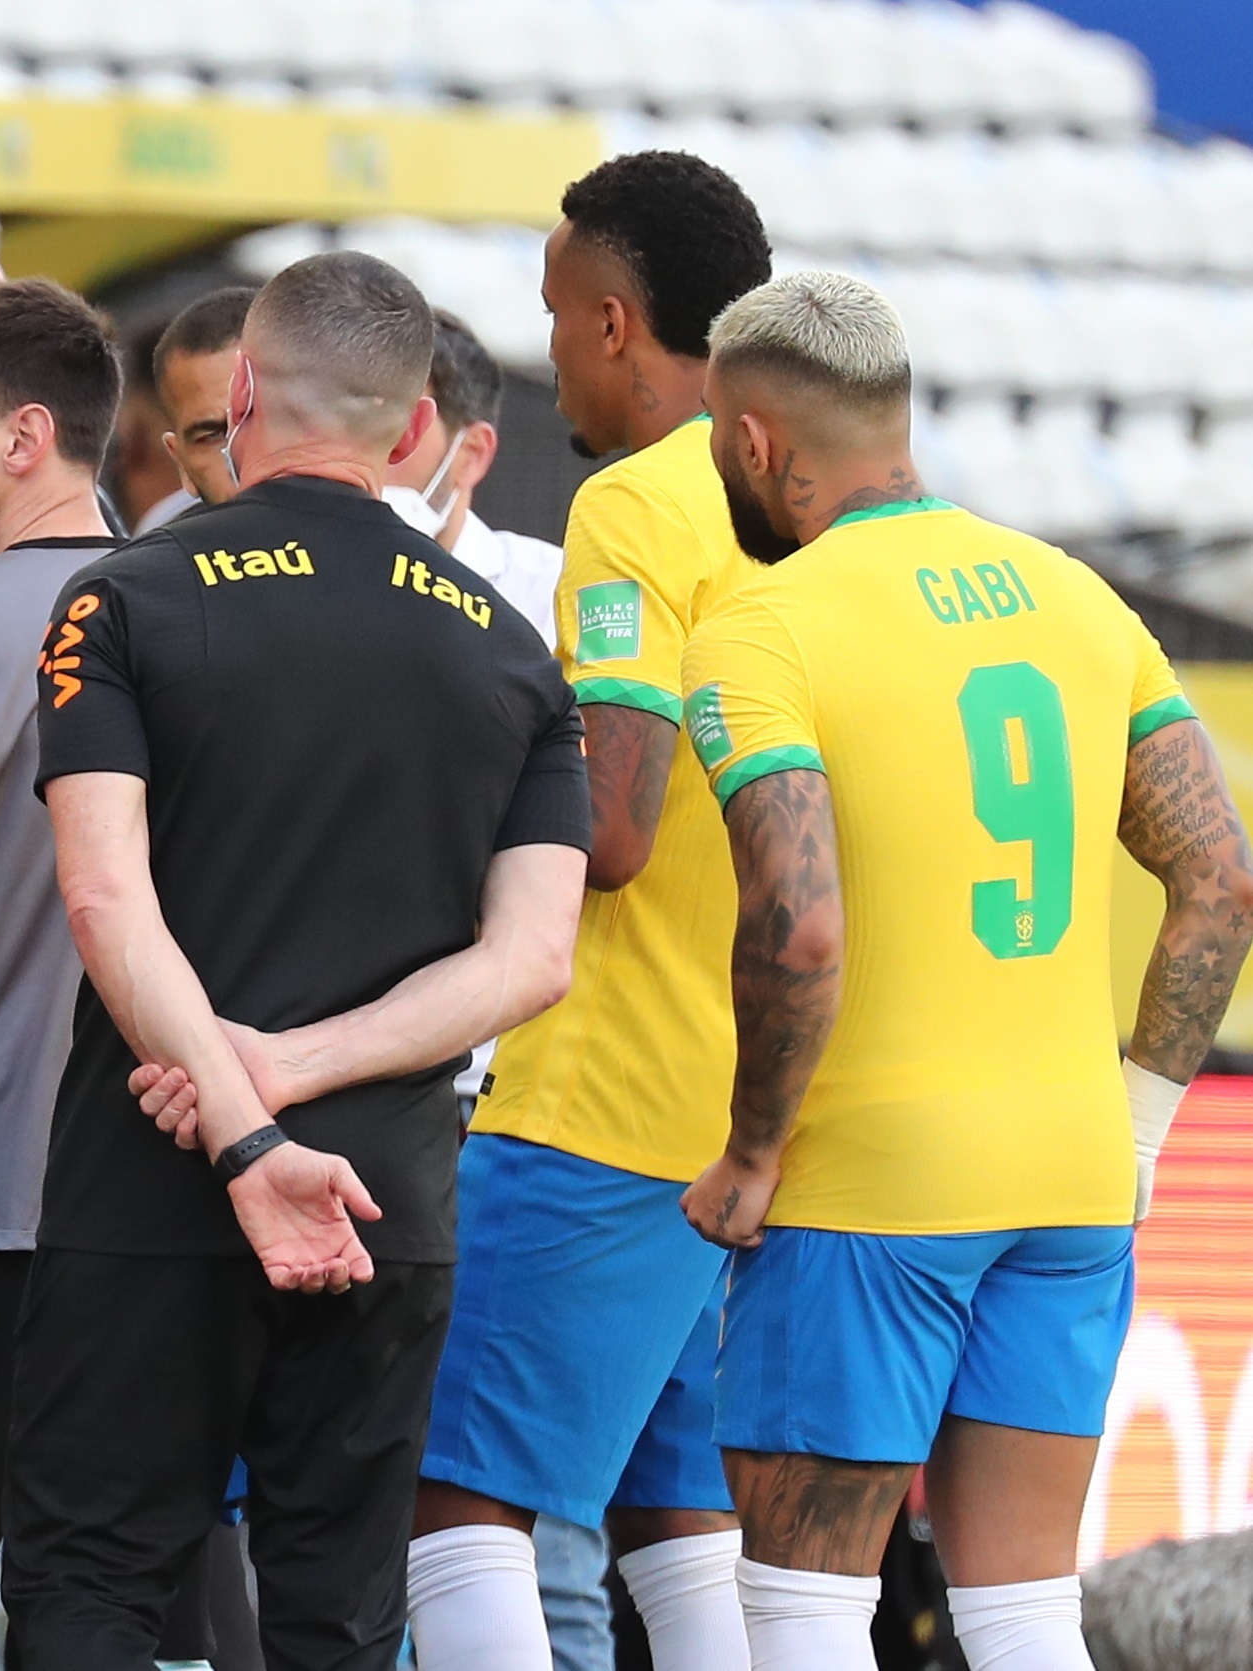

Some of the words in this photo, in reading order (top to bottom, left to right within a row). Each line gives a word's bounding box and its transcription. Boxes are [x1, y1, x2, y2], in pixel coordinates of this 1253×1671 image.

[194, 541, 315, 586] Itaú
[391, 554, 493, 629] Itaú
[915, 559, 1037, 625] GABI
[582, 603, 634, 618] LIVING
[606, 628, 633, 639] FIFA
[44, 594, 100, 709] vivo
[956, 660, 1075, 960] 9
